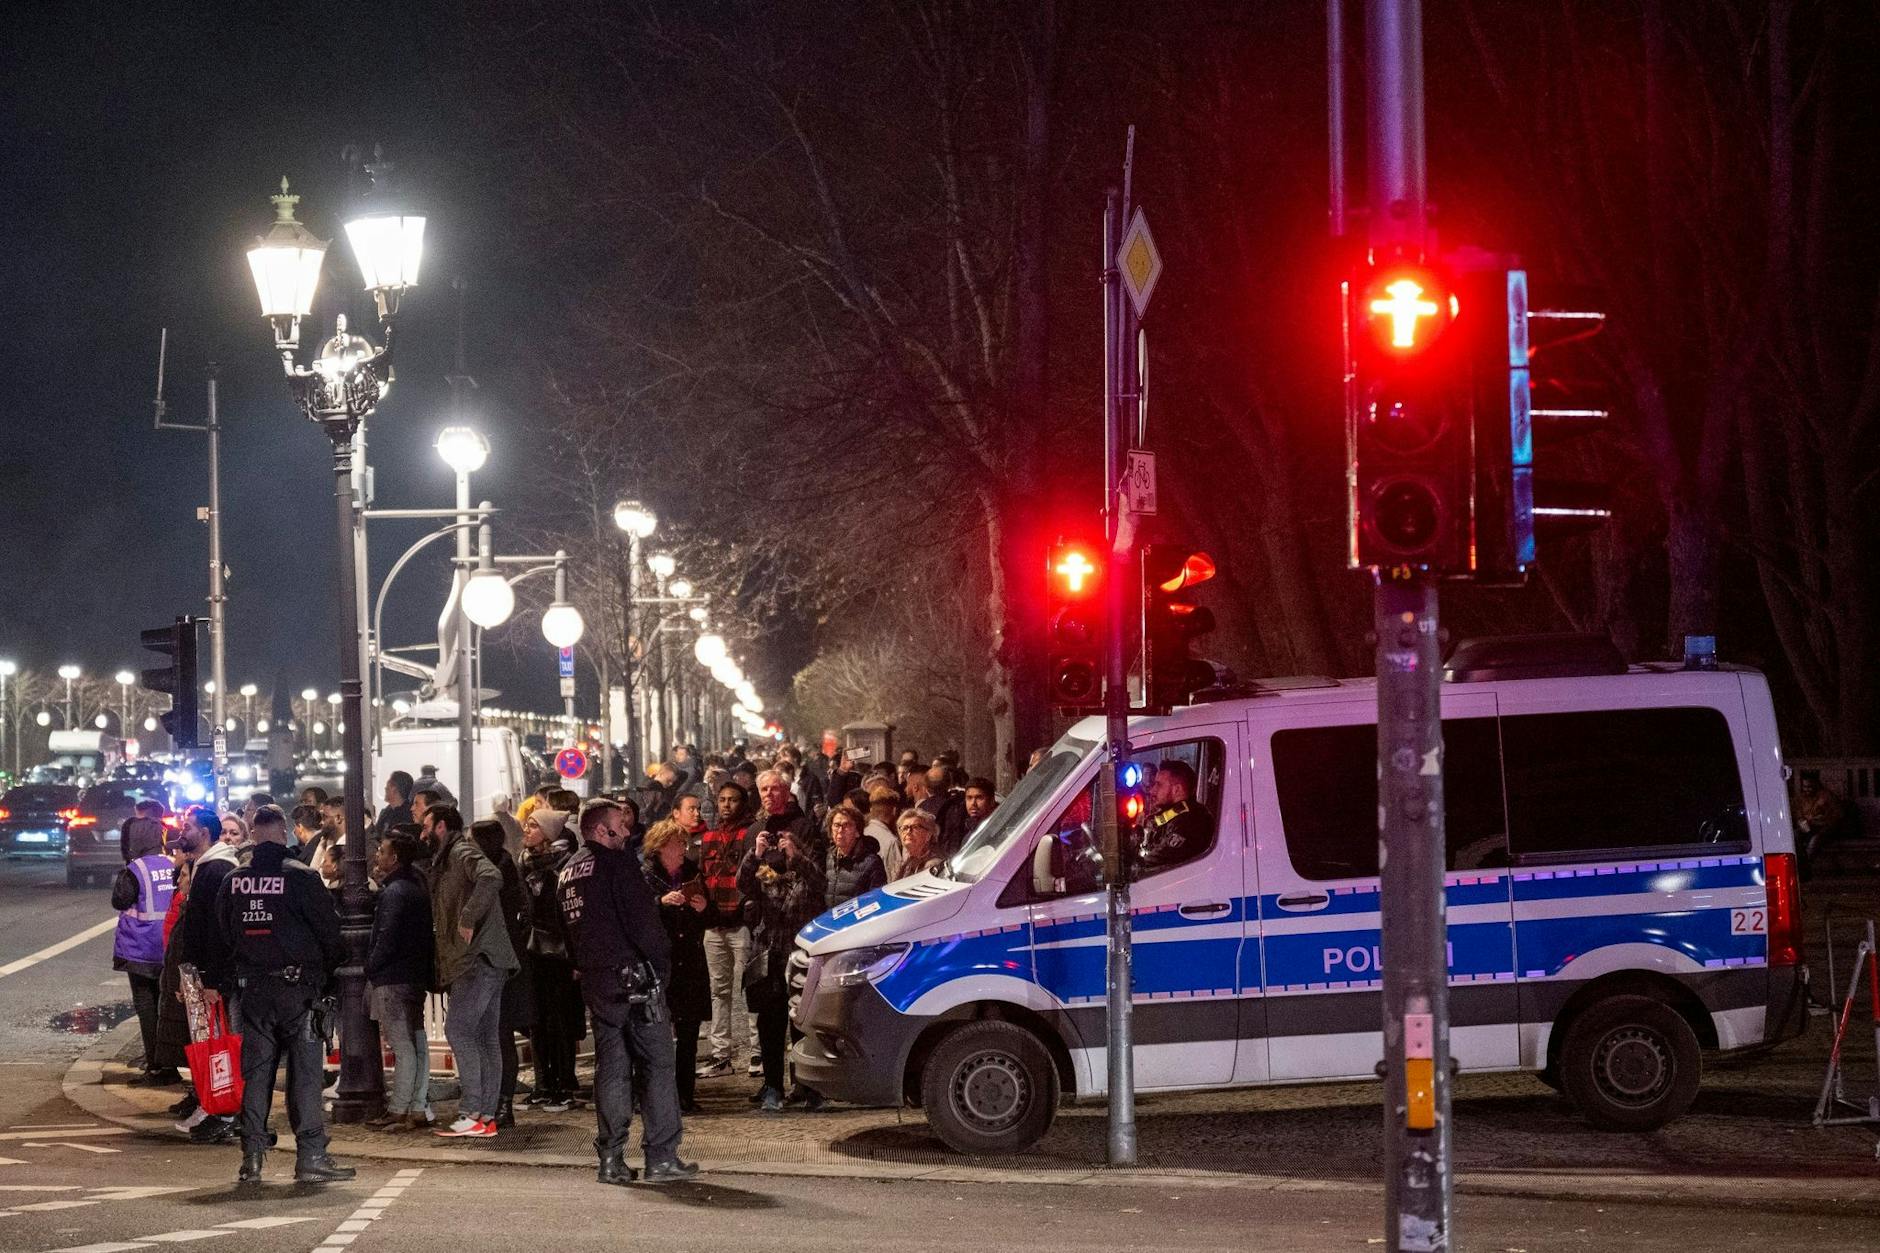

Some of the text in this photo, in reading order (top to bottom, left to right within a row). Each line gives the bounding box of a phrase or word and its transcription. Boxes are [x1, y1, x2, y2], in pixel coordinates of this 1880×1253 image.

[231, 876, 285, 895] POLIZEI
[565, 886, 577, 900] BE
[249, 899, 264, 911] BE
[241, 910, 273, 922] 2212a
[1733, 911, 1765, 932] 22
[1323, 941, 1454, 975] POLI
